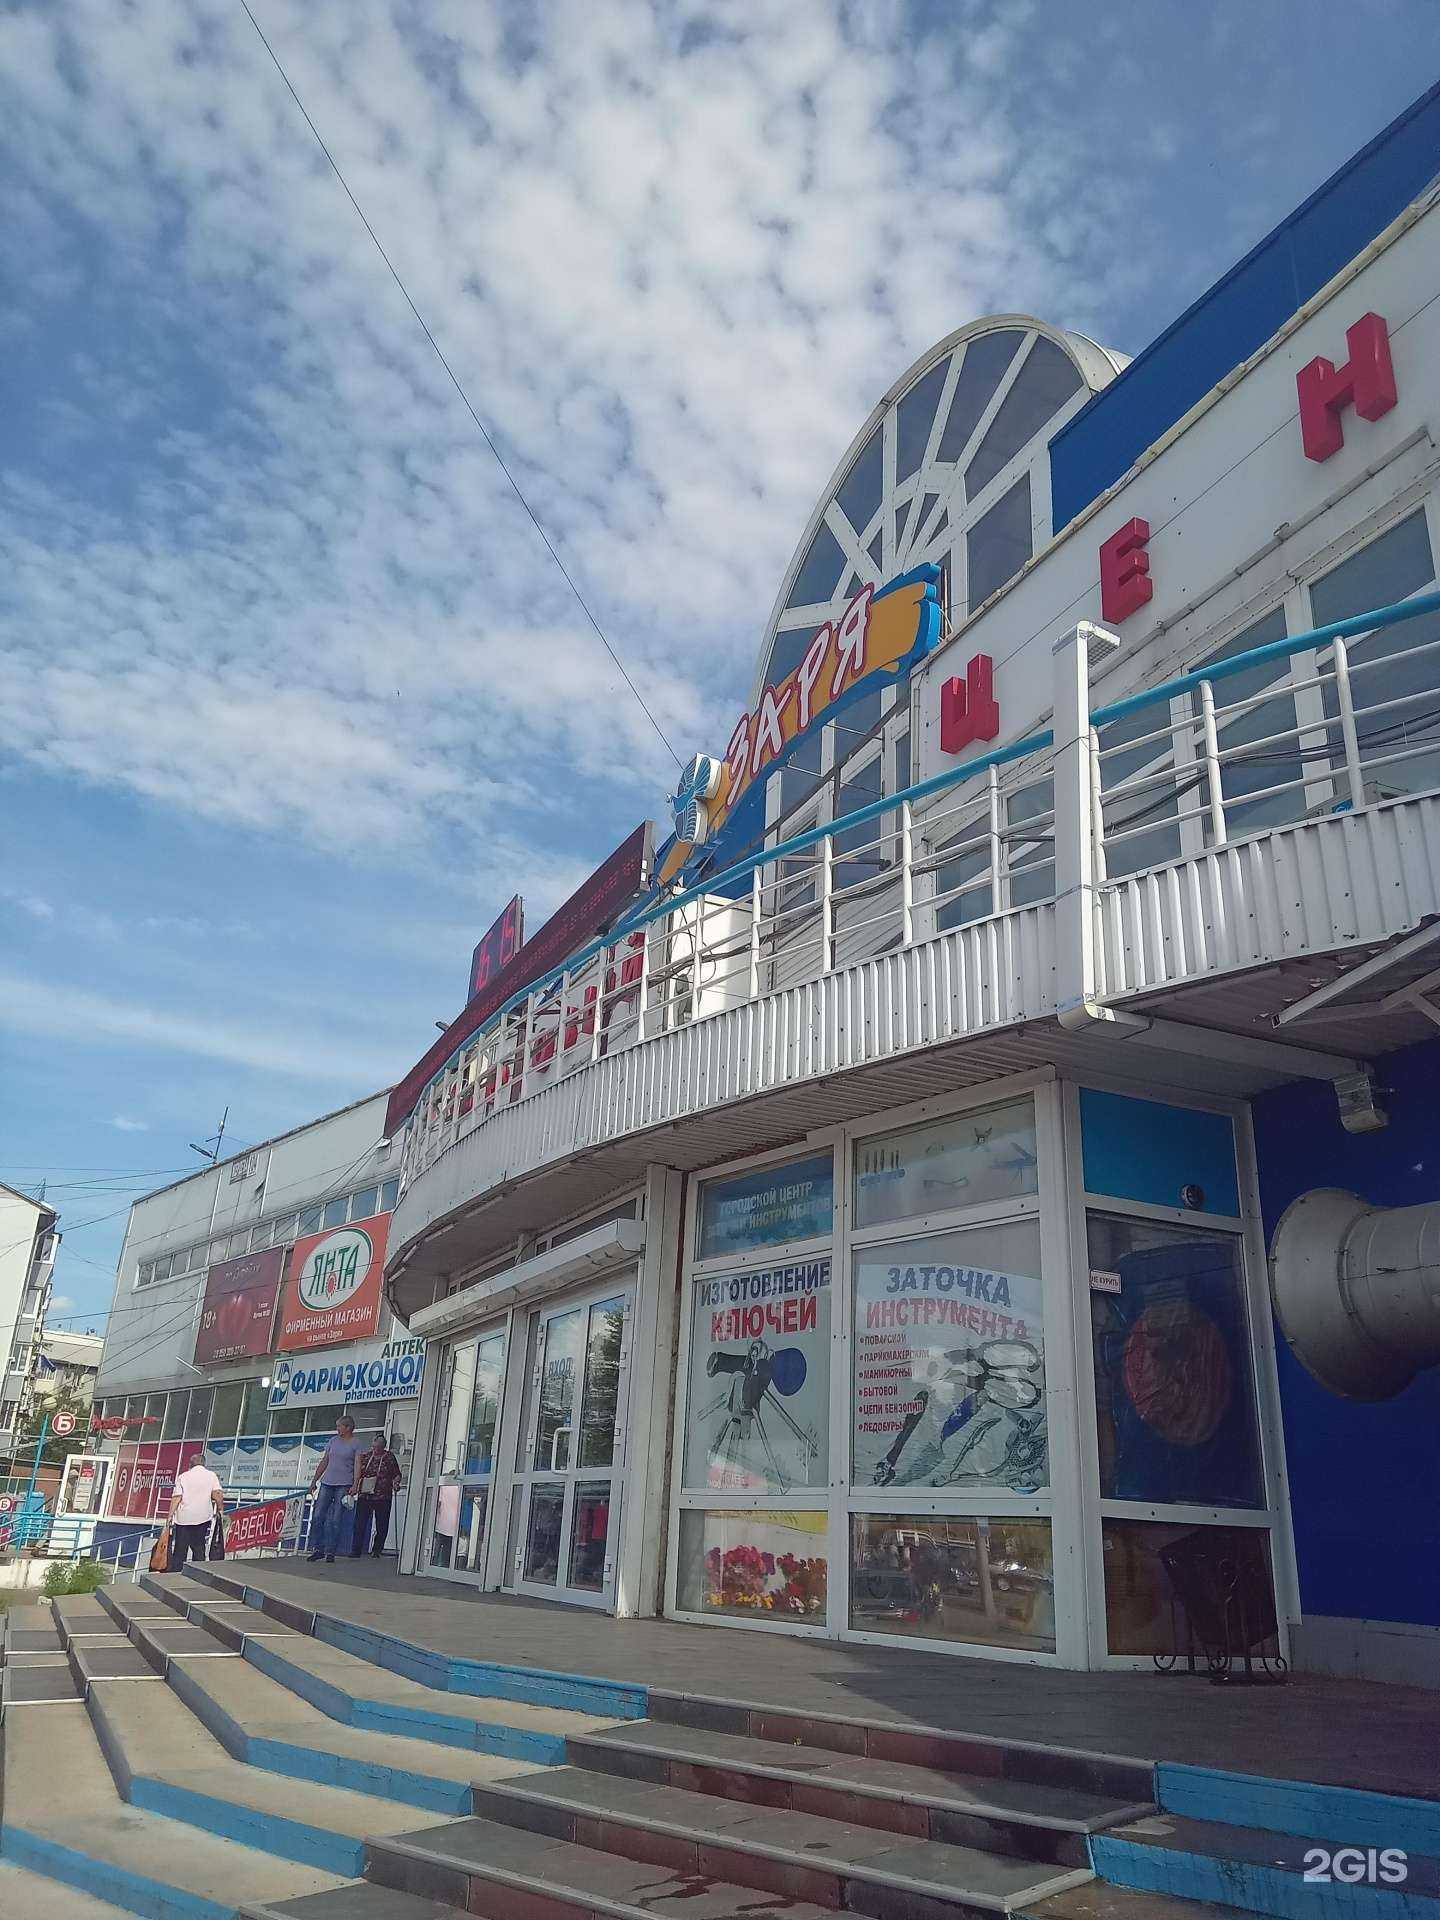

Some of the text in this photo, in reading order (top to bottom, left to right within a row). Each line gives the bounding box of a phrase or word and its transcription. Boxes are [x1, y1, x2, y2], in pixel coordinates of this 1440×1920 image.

[726, 582, 875, 811] ЗАРЯ
[779, 1181, 813, 1203] ЦЕНТР
[308, 1243, 361, 1298] ЯНТА
[701, 1261, 831, 1307] ИЗГОТОВЛЕНИЕ
[885, 1266, 1012, 1308] ЗАТОЧКА
[286, 1311, 333, 1334] ФИРМЕННЫЙ
[335, 1305, 373, 1325] МАГАЗИН
[711, 1289, 818, 1343] КЛЮЧЕЙ
[866, 1298, 1030, 1340] ИНСТРУМЕНТА
[863, 1404, 883, 1416] ЦЕПИ
[226, 1509, 285, 1543] FABERLIC
